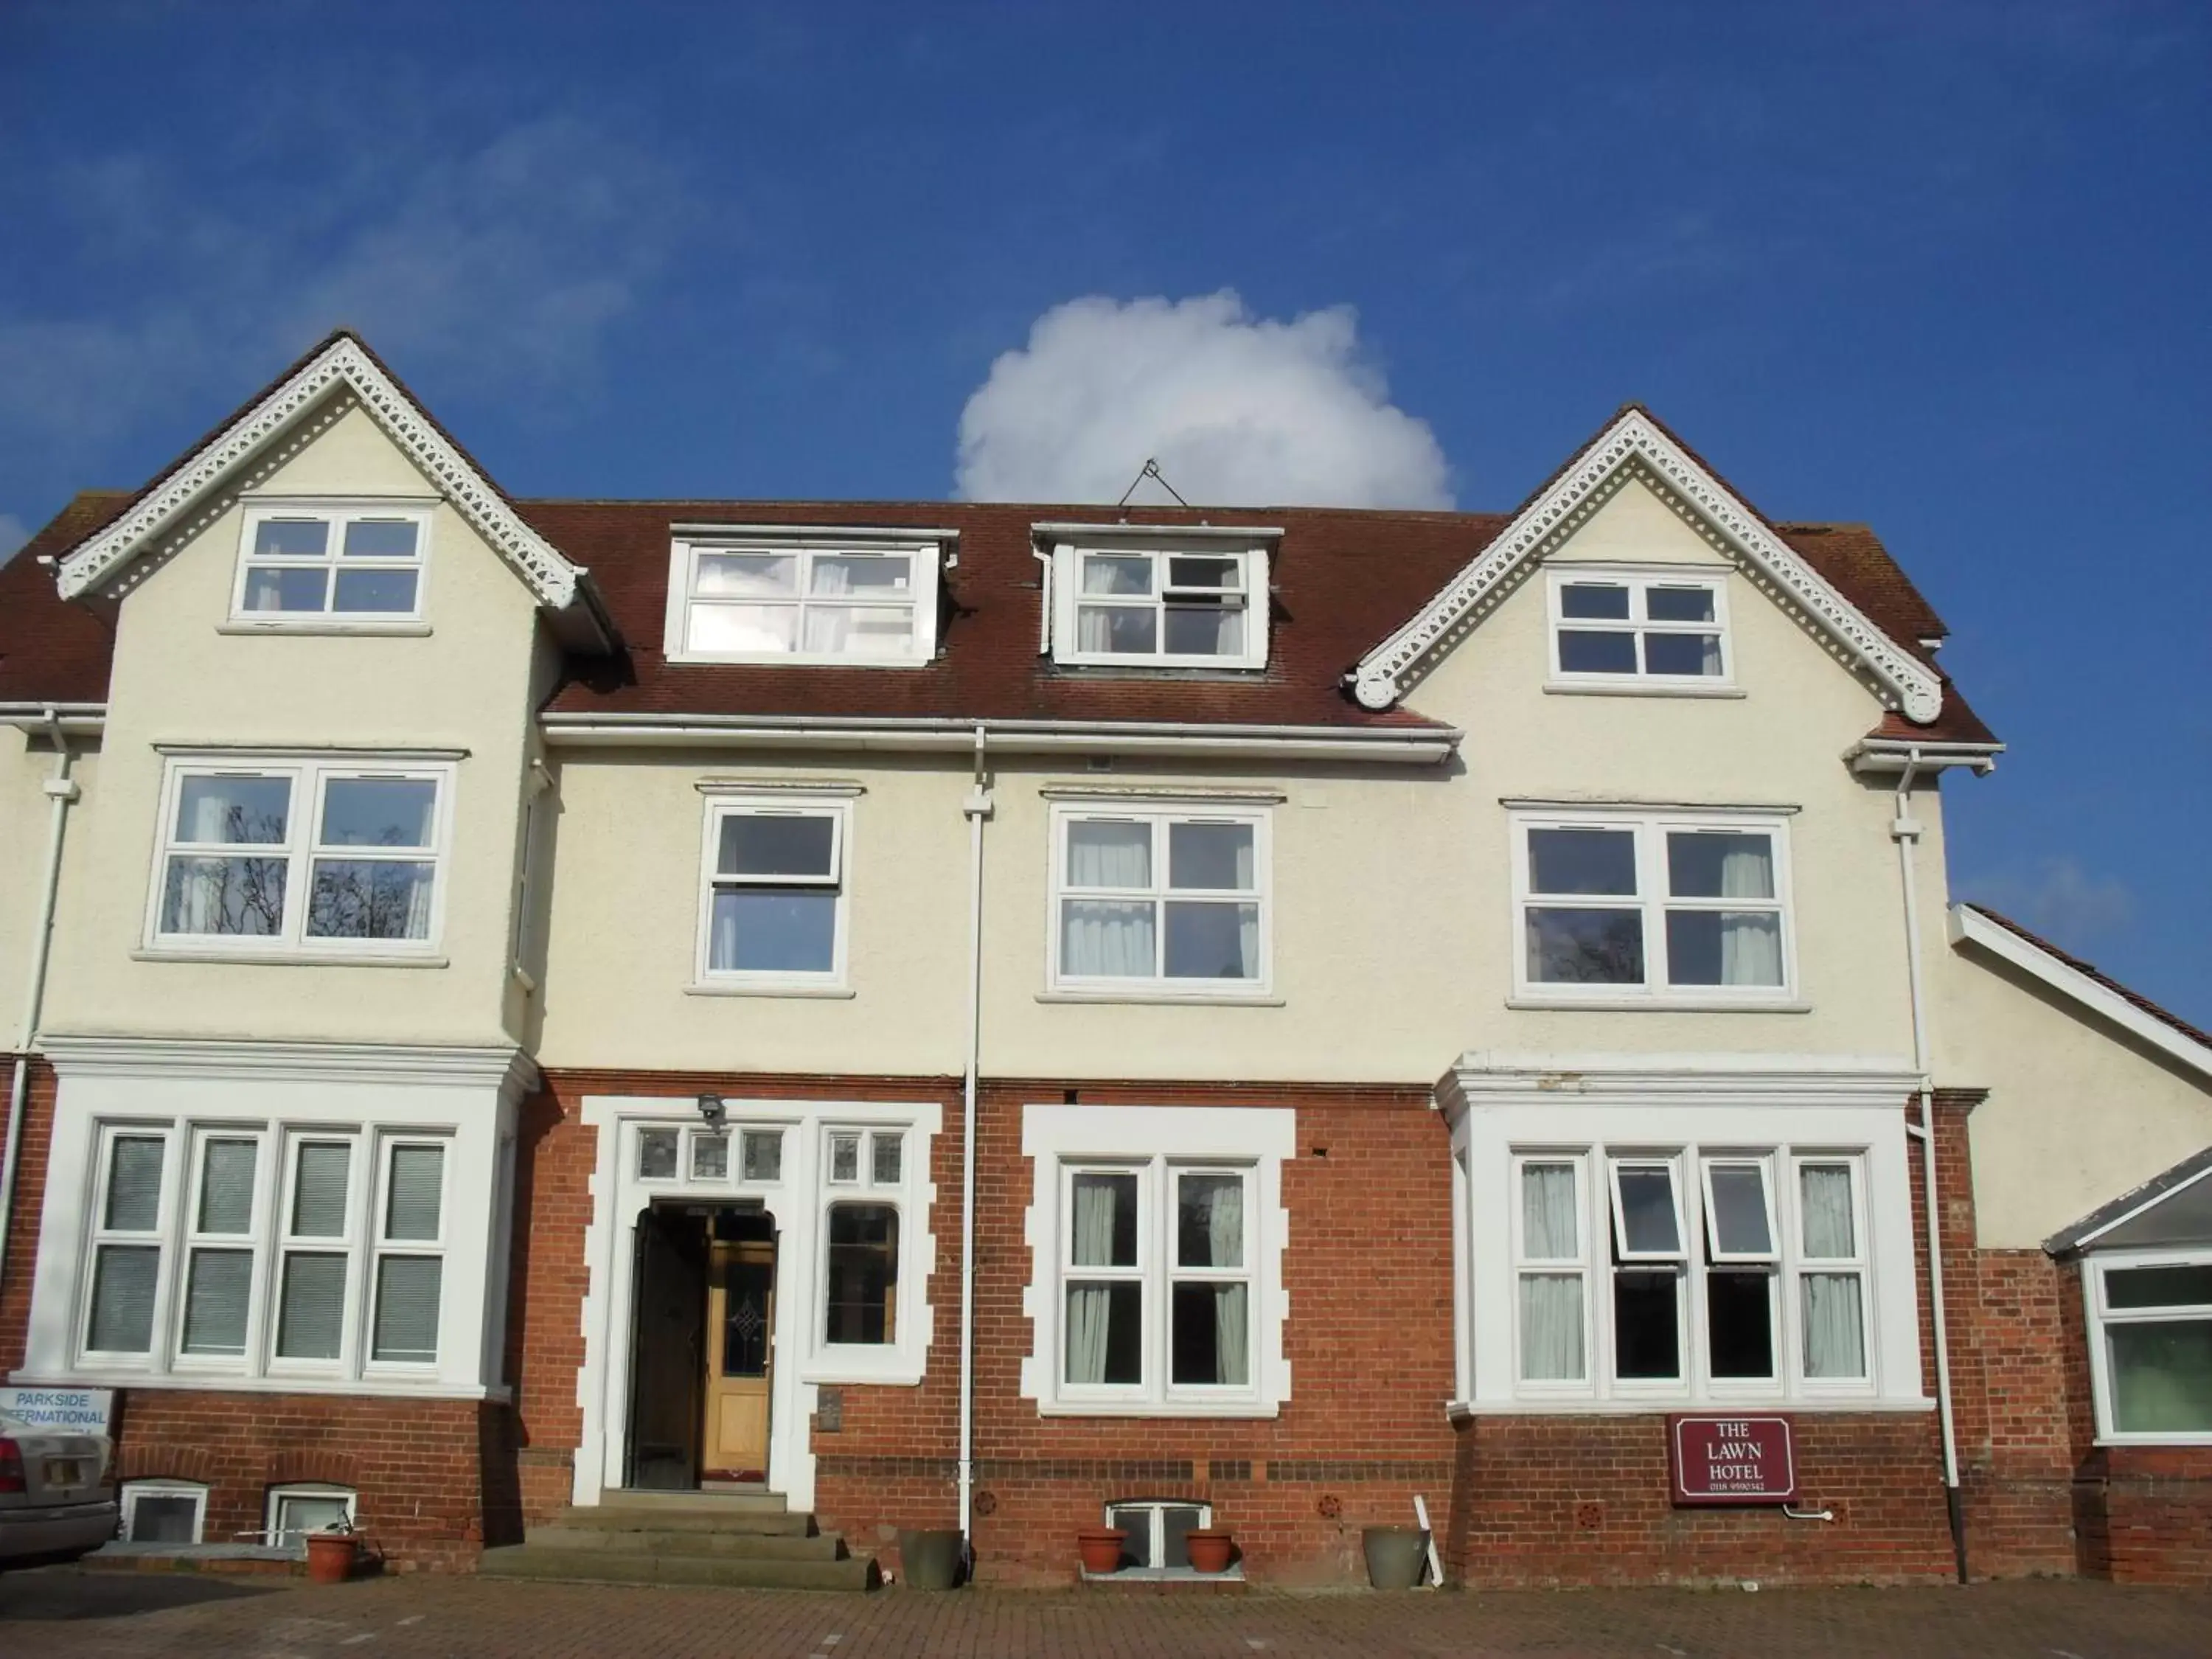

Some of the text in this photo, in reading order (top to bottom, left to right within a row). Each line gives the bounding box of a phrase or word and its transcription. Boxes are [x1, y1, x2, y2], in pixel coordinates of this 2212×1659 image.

[16, 1393, 89, 1407] PARKSIDE
[1716, 1422, 1750, 1438] THE
[1706, 1441, 1764, 1461] LAWN
[1710, 1465, 1764, 1480] HOTEL
[1710, 1483, 1728, 1491] 0118
